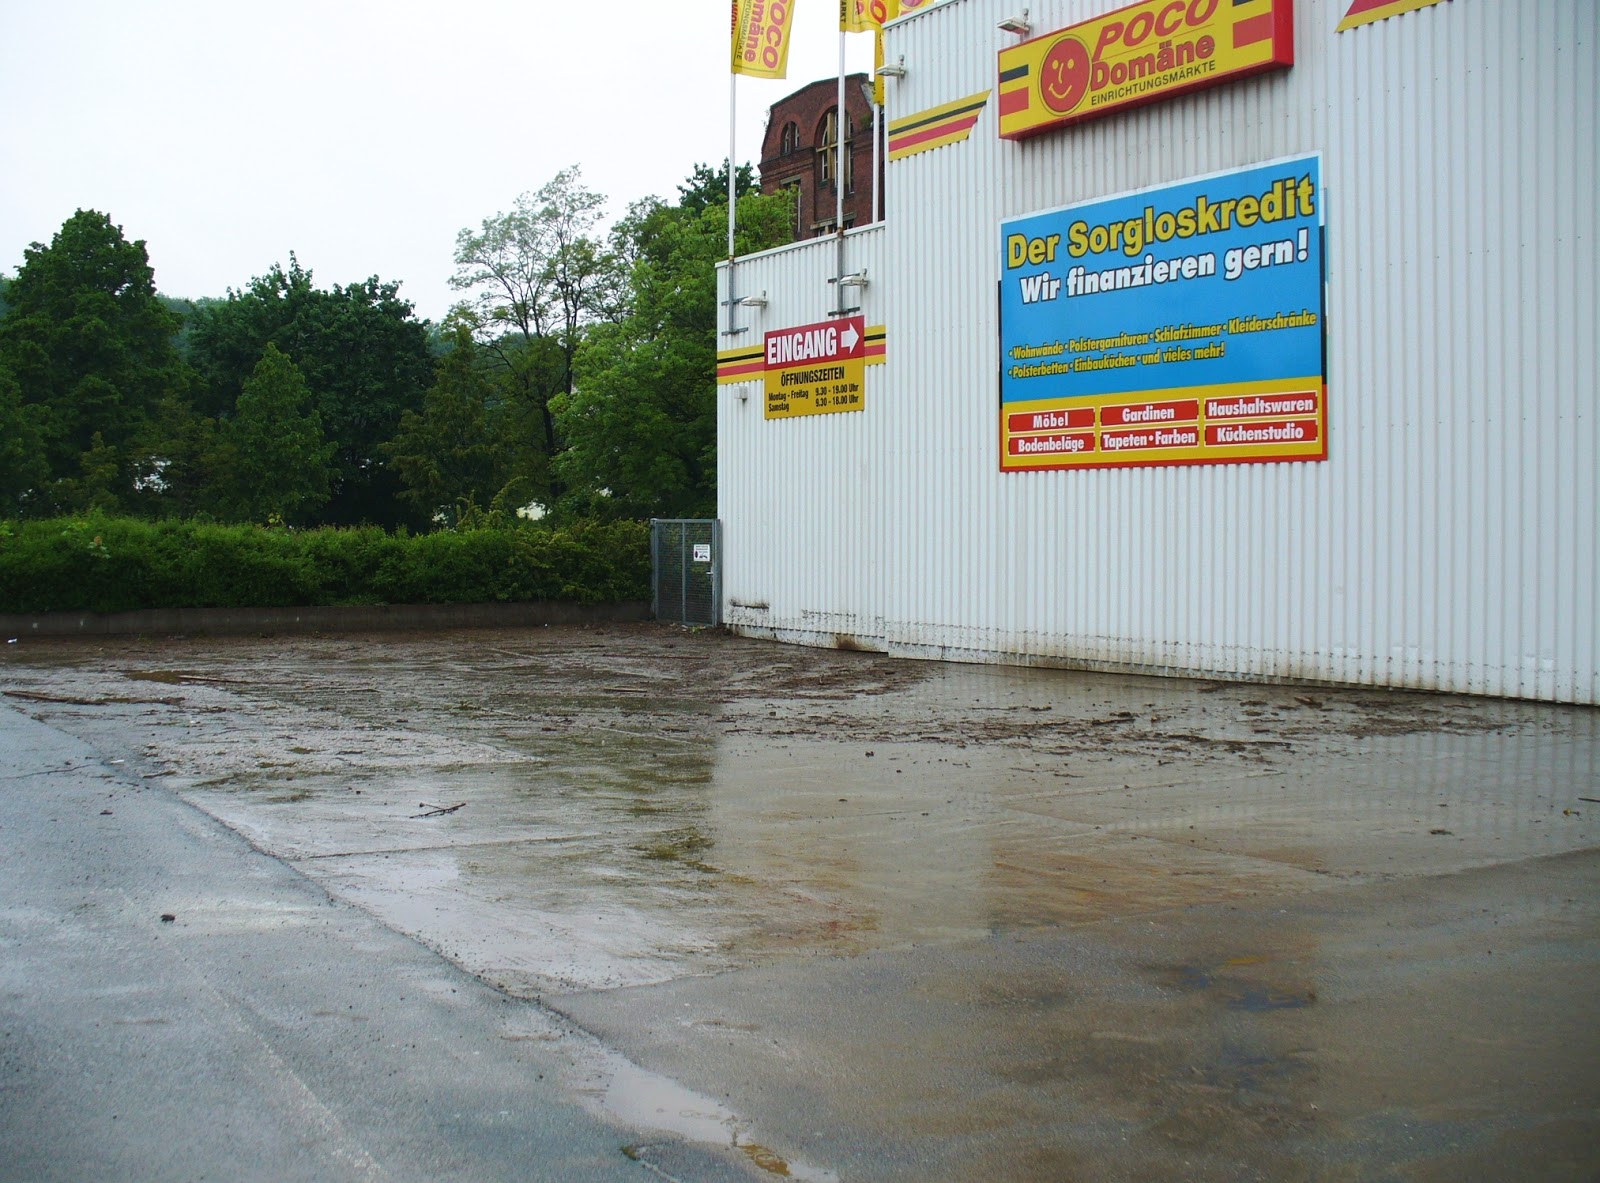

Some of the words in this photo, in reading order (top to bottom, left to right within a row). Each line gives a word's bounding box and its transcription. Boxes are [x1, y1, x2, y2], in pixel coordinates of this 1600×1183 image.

[763, 0, 787, 68] OCO
[1091, 0, 1218, 62] POCO
[1090, 34, 1216, 92] Domäne
[1091, 60, 1216, 106] EINRICHTUNGSMÄRKTE
[1007, 231, 1061, 269] Der
[1067, 173, 1315, 257] Sorgloskredit
[1019, 271, 1061, 305] Wir
[1066, 252, 1215, 298] finanzieren
[1223, 227, 1309, 280] gern!
[1227, 308, 1317, 335] Kleiderschränke
[767, 327, 837, 365] EINGANG
[1141, 349, 1161, 365] und
[1162, 345, 1192, 363] vieles
[1194, 341, 1226, 360] mehr!
[781, 366, 845, 387] ÖFFNUNGSZEITEN
[768, 392, 787, 402] Montag
[790, 389, 809, 400] Freitag
[815, 386, 827, 396] 9.30
[848, 383, 859, 393] Uhr
[768, 402, 790, 412] Samstag
[815, 397, 827, 407] 9.30
[848, 394, 859, 404] Uhr
[1122, 405, 1175, 422] Gardinen
[1208, 397, 1313, 416] Haushaltswaren
[1033, 412, 1068, 429] Möbel
[1103, 433, 1147, 450] Tapeten
[1155, 429, 1196, 445] Farben
[1217, 422, 1304, 442] Küchenstudio
[1018, 436, 1084, 452] Bodenbeläge
